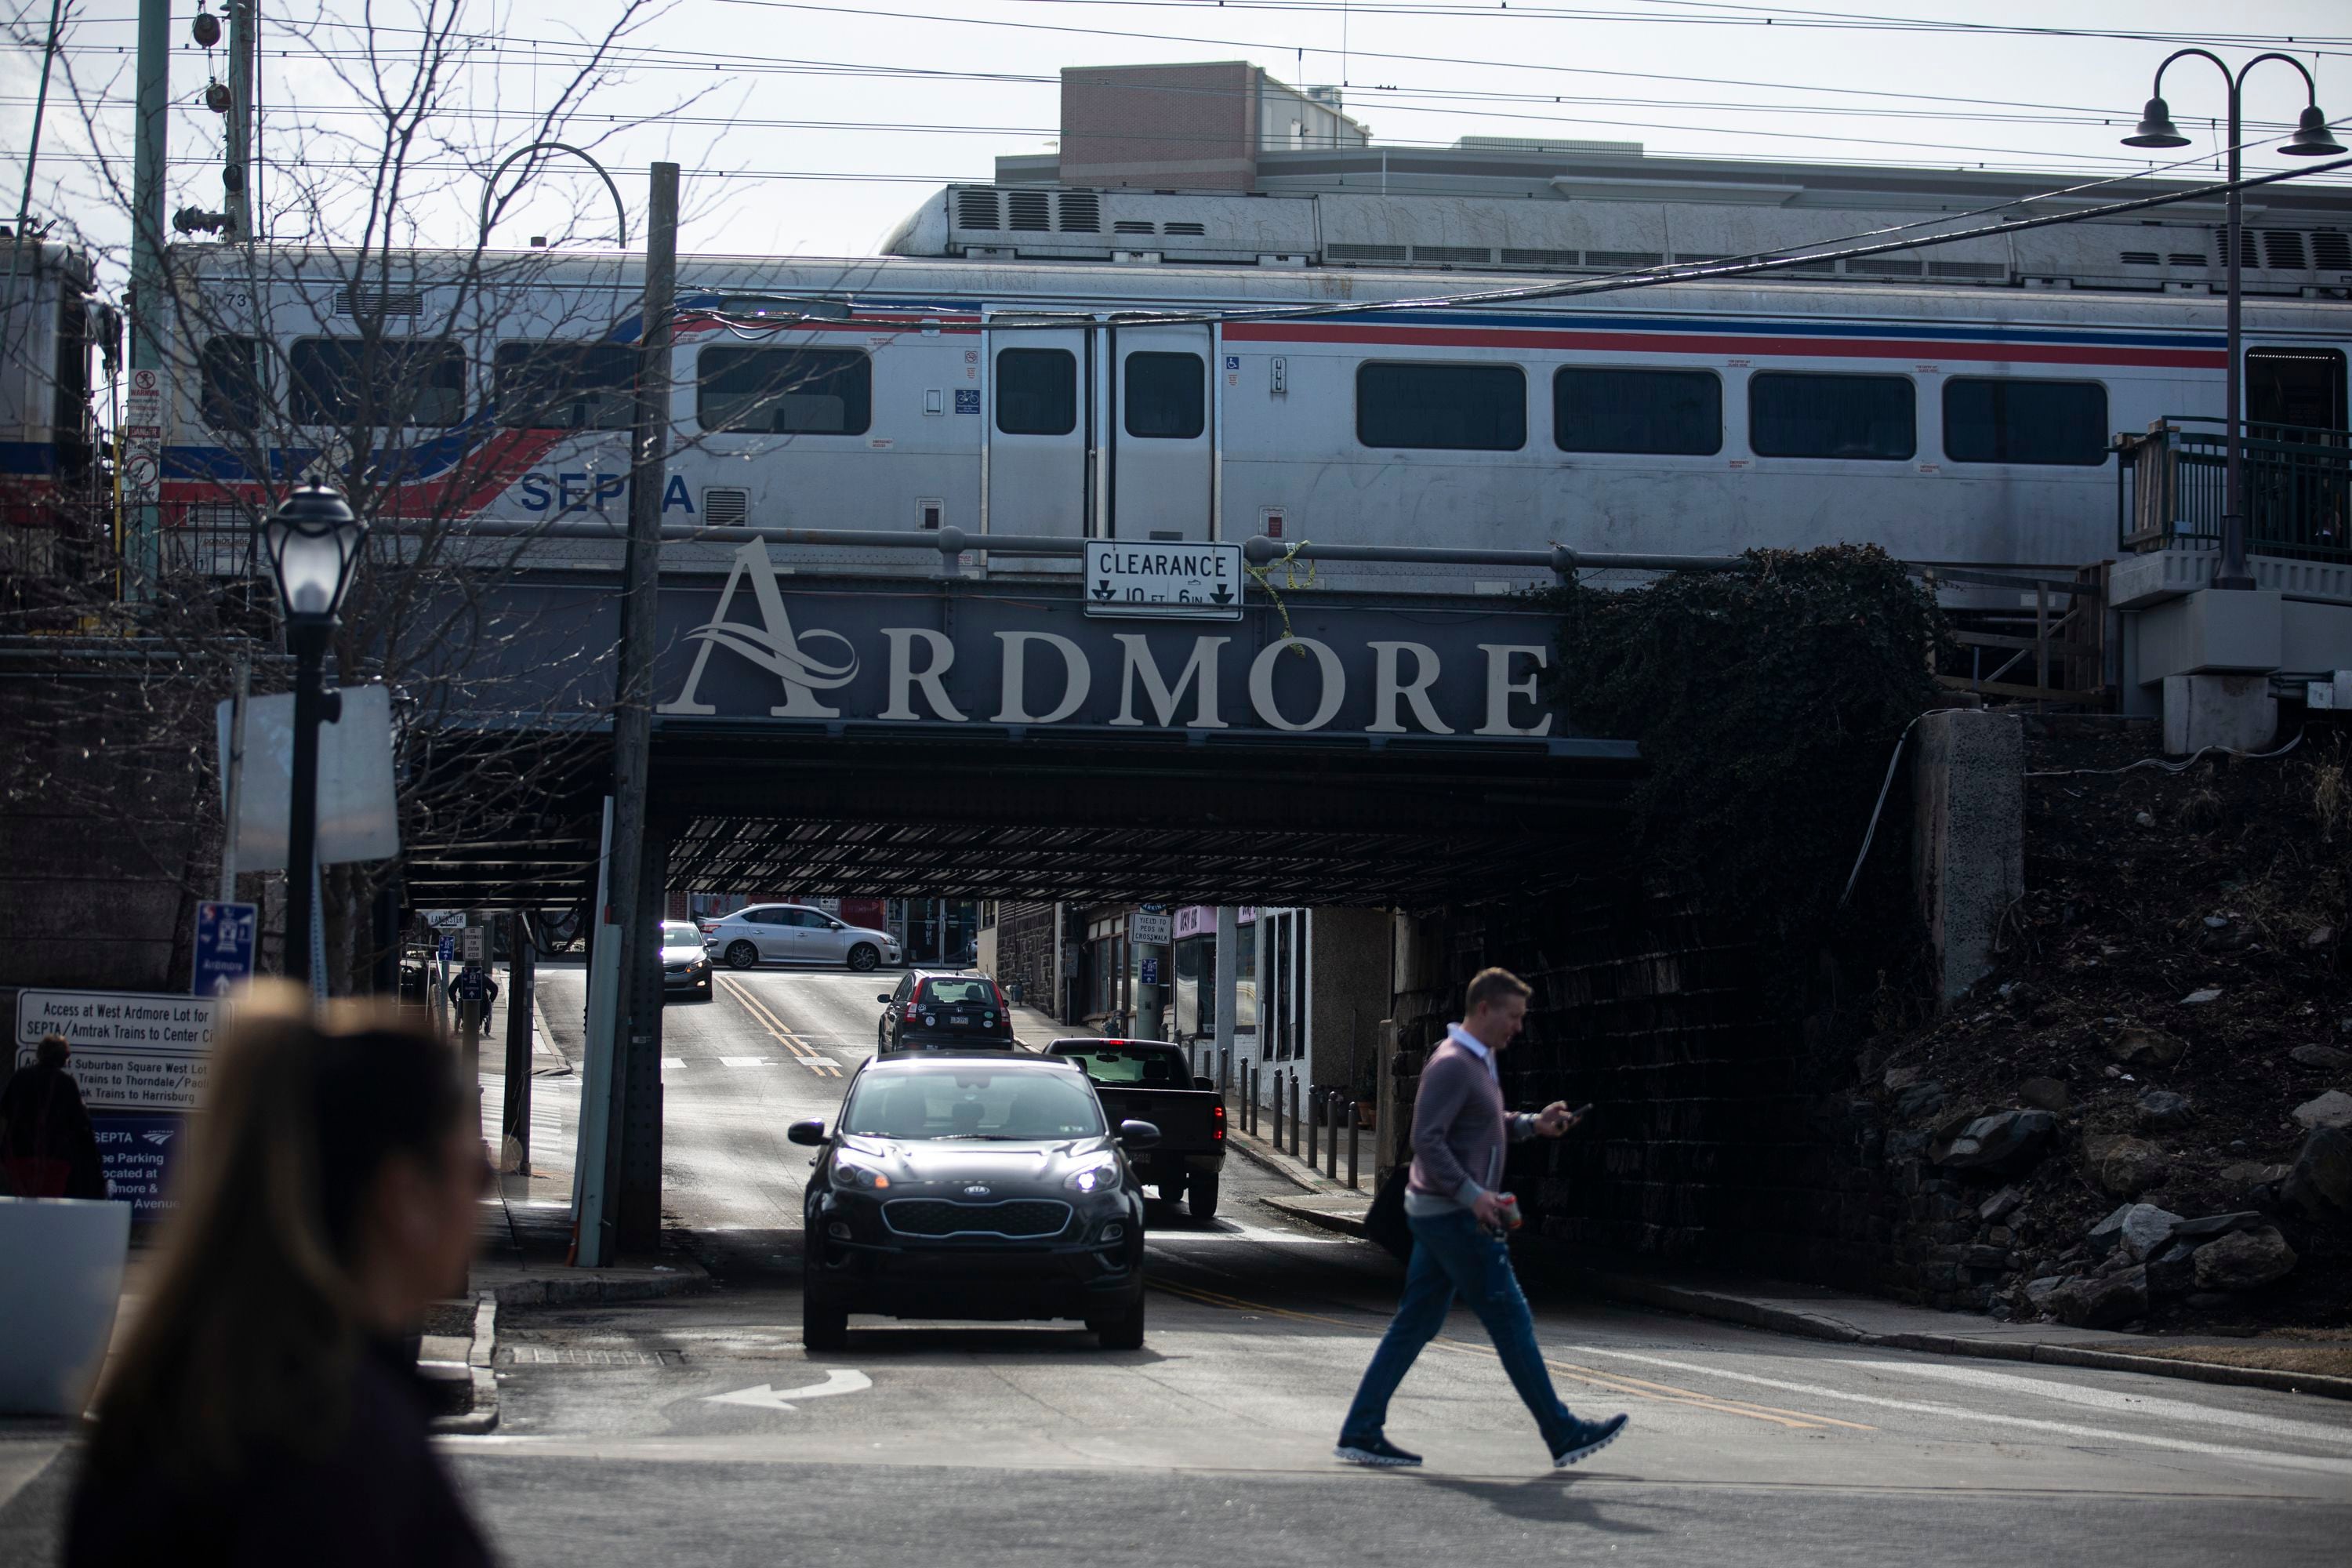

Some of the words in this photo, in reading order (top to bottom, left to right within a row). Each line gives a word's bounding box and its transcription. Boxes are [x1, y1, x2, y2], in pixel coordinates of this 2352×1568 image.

[521, 472, 695, 514] SEPA
[1100, 553, 1226, 577] CLEARANCE
[1127, 587, 1145, 602] 10
[1179, 590, 1189, 603] 6
[656, 535, 1553, 738] ARDMORE
[431, 915, 463, 924] LANCASTER
[44, 1002, 78, 1017] Access
[83, 1004, 93, 1018] at
[97, 1004, 121, 1018] West
[125, 1006, 169, 1021] Ardmore
[173, 1008, 191, 1022] Lot
[194, 1009, 209, 1022] for
[27, 1020, 110, 1038] SEPTA/Amtrak
[114, 1025, 145, 1040] Trains
[149, 1027, 159, 1040] to
[164, 1027, 198, 1042] Center
[75, 1059, 123, 1072] Suburban
[127, 1062, 162, 1074] Square
[165, 1062, 187, 1074] West
[191, 1064, 207, 1075] Lot
[79, 1073, 108, 1084] Trains
[112, 1075, 122, 1086] to
[96, 1088, 125, 1099] Trains
[129, 1090, 139, 1100] to
[143, 1090, 194, 1105] Harrisburg
[118, 1153, 164, 1165] Parking
[102, 1169, 143, 1178] ocated
[146, 1169, 157, 1178] at
[149, 1183, 158, 1193] &
